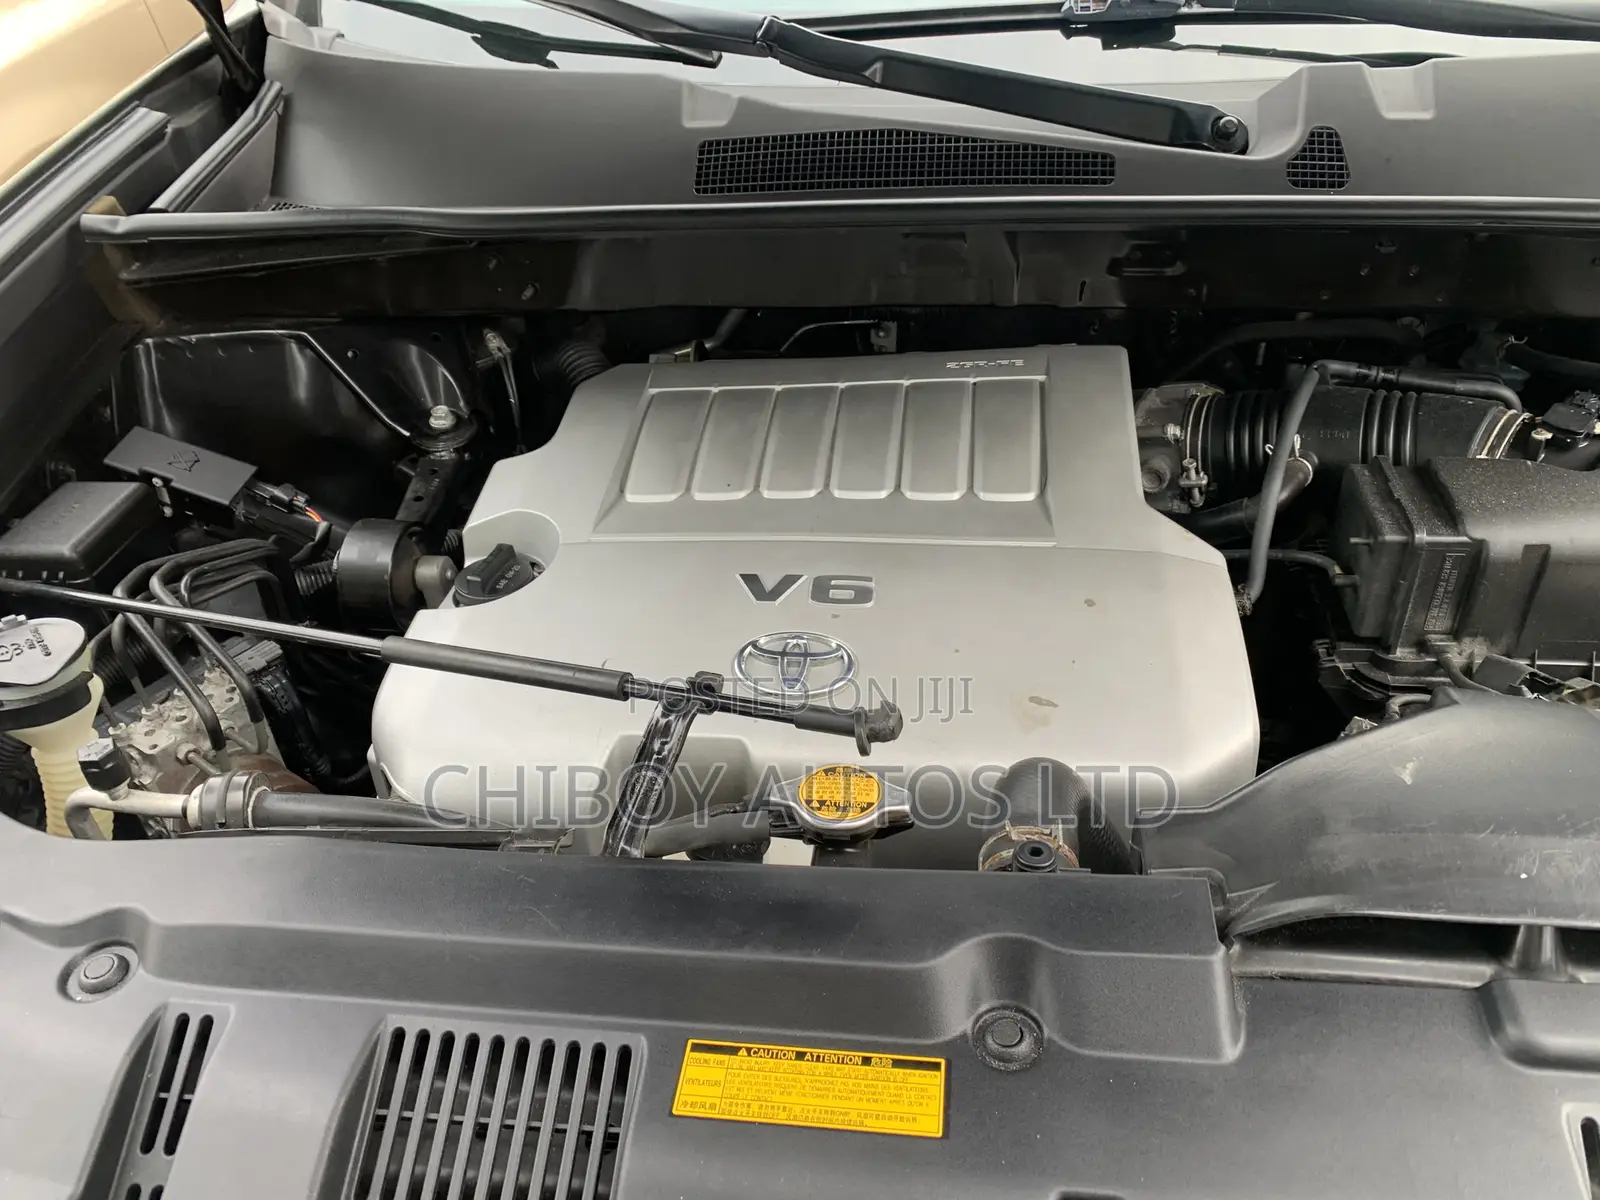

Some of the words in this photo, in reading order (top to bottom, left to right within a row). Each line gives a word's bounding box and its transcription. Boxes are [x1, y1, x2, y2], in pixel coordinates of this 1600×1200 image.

[735, 573, 876, 609] V6
[828, 771, 866, 779] CAUTION
[825, 799, 868, 808] ATTENTION
[689, 1056, 711, 1064] COOLING
[712, 1058, 726, 1066] FANS
[750, 1048, 796, 1061] CAUTION
[804, 1052, 862, 1065] ATTENTION
[685, 1077, 721, 1087] VENTILATEURS
[679, 1099, 717, 1110] 冷却风扇
